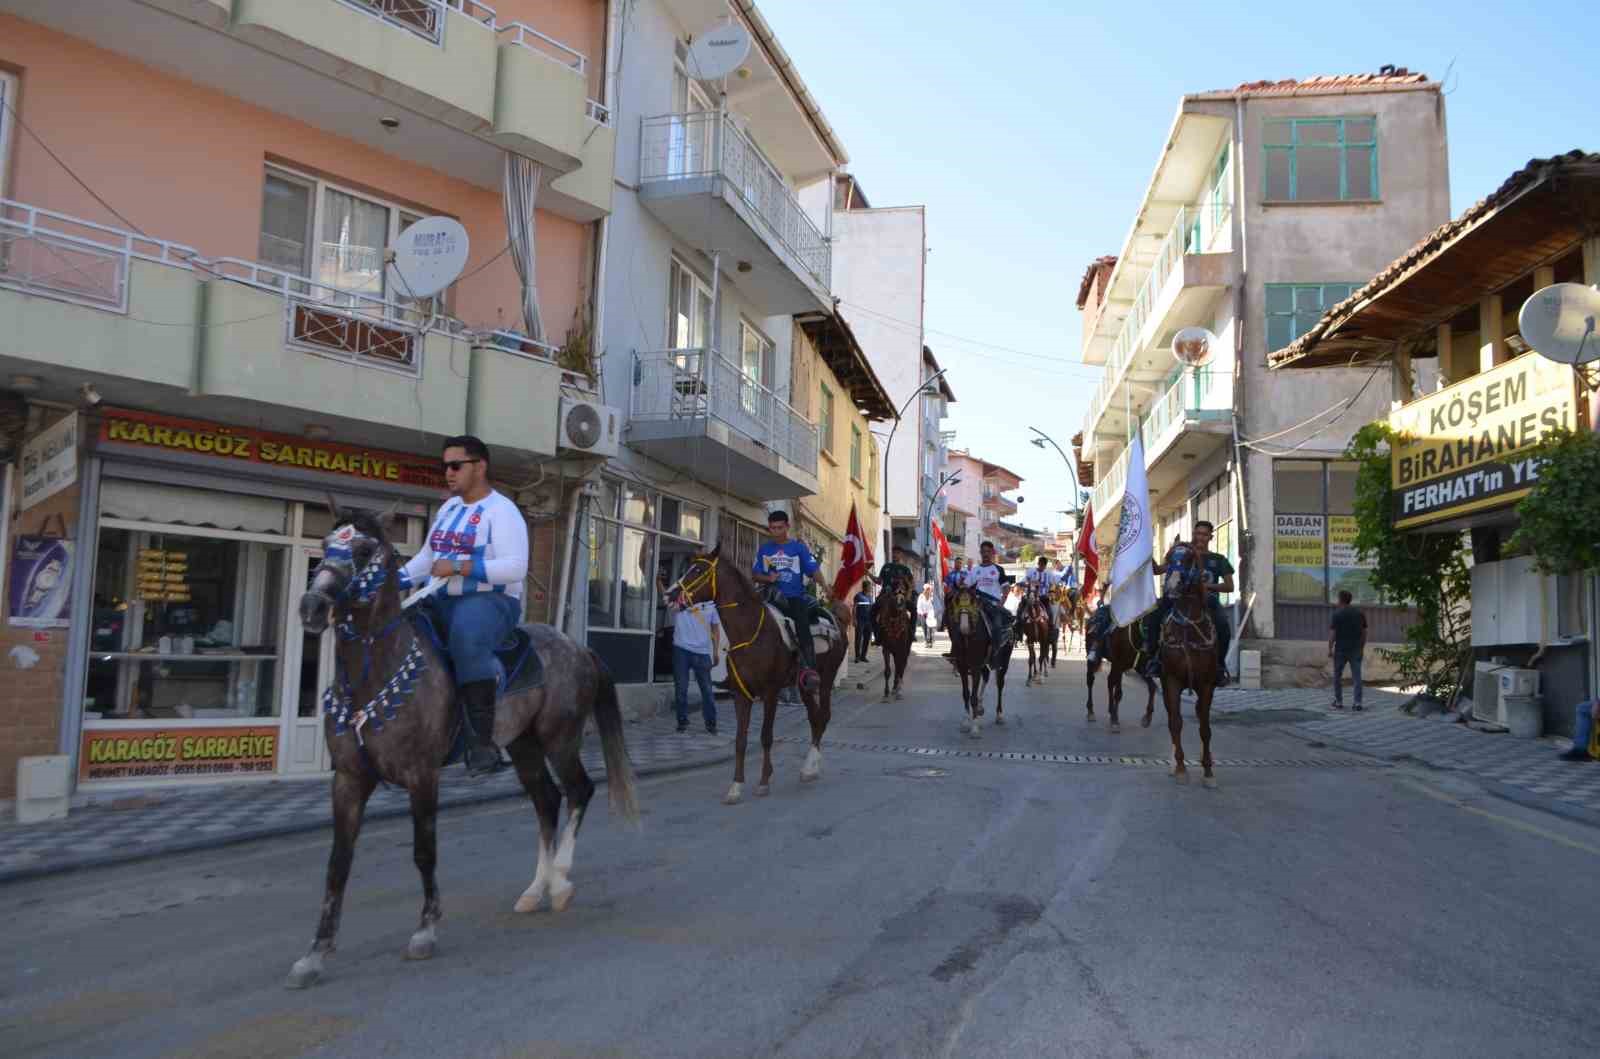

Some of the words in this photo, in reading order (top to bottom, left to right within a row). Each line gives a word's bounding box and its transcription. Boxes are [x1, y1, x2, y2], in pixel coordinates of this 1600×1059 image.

[1430, 371, 1527, 434] KÖŞEM
[109, 419, 251, 458] KARAGÖZ
[259, 441, 399, 480] SARRAFİYE
[1276, 516, 1322, 527] DABAN
[89, 732, 177, 763] KARAGÖZ
[181, 729, 274, 760] SARRAFİYE
